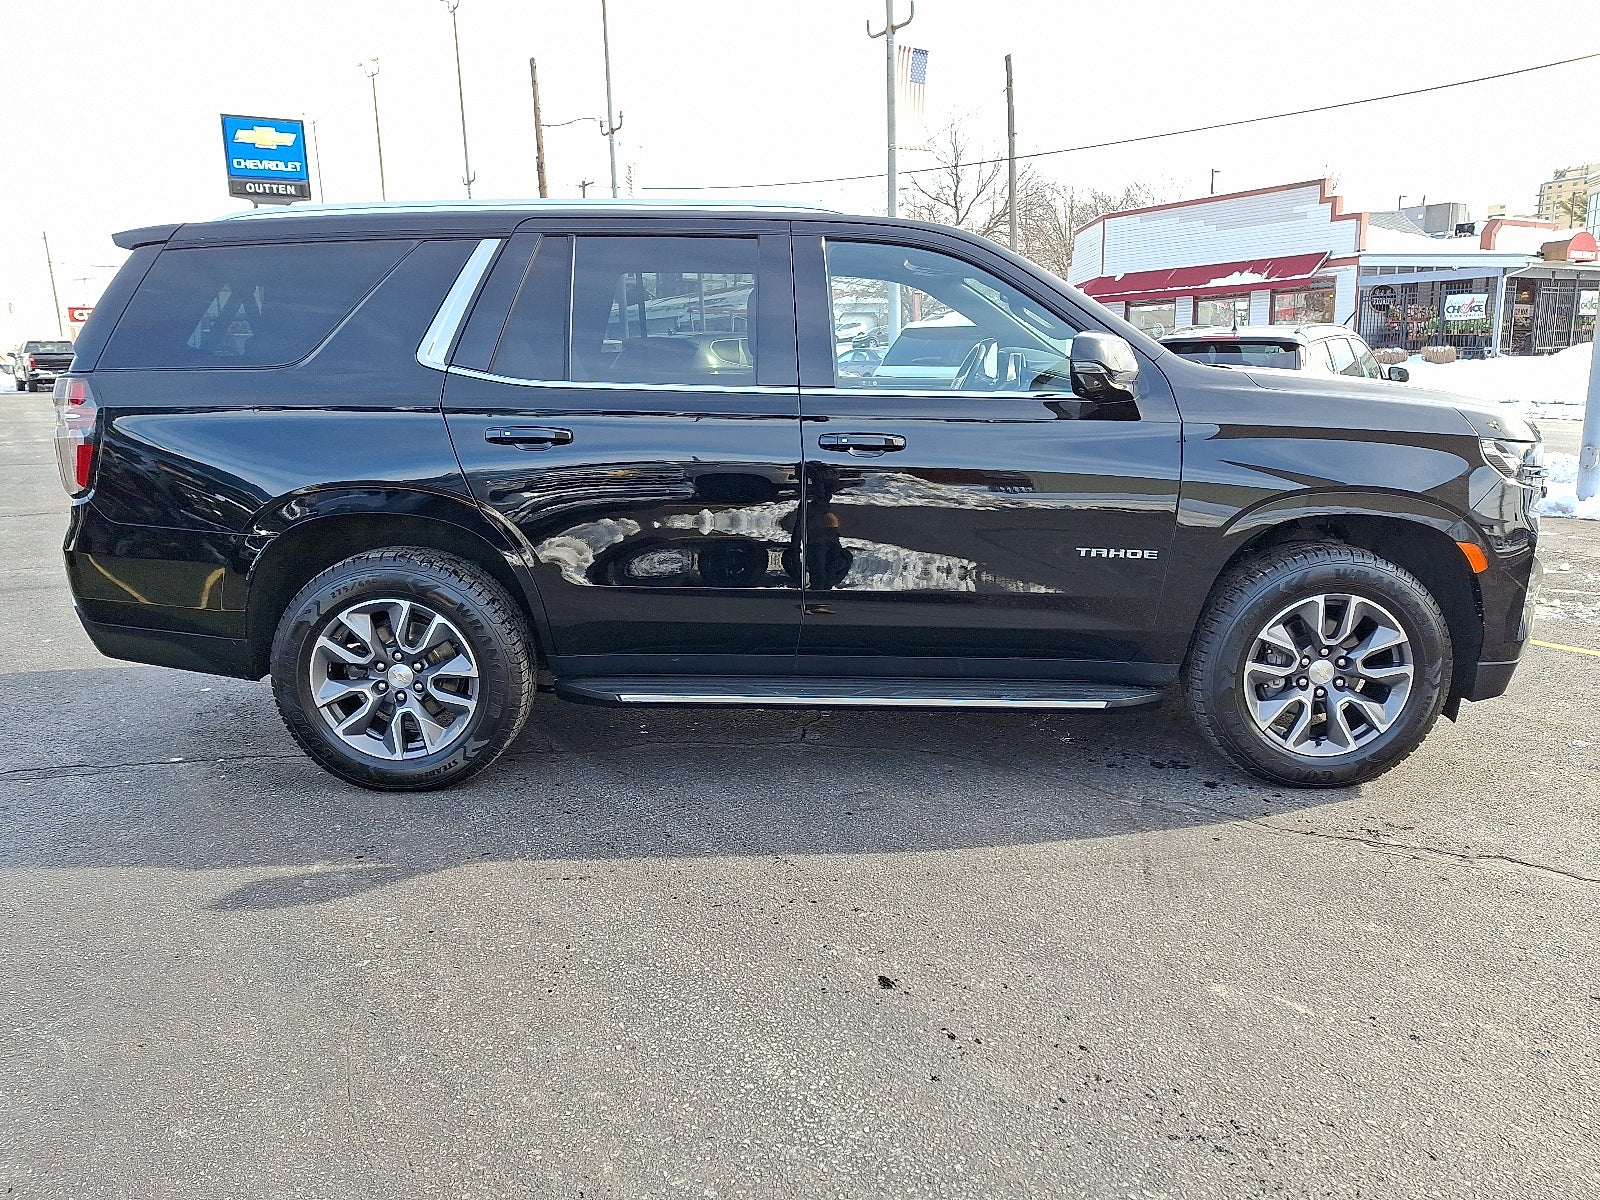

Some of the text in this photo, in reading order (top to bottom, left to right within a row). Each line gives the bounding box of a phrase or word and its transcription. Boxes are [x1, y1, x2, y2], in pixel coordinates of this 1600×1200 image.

[232, 158, 302, 172] CHEVROLET
[245, 183, 296, 195] OUTTEN
[1446, 303, 1484, 314] CHOICE
[1075, 547, 1159, 560] TAHOE
